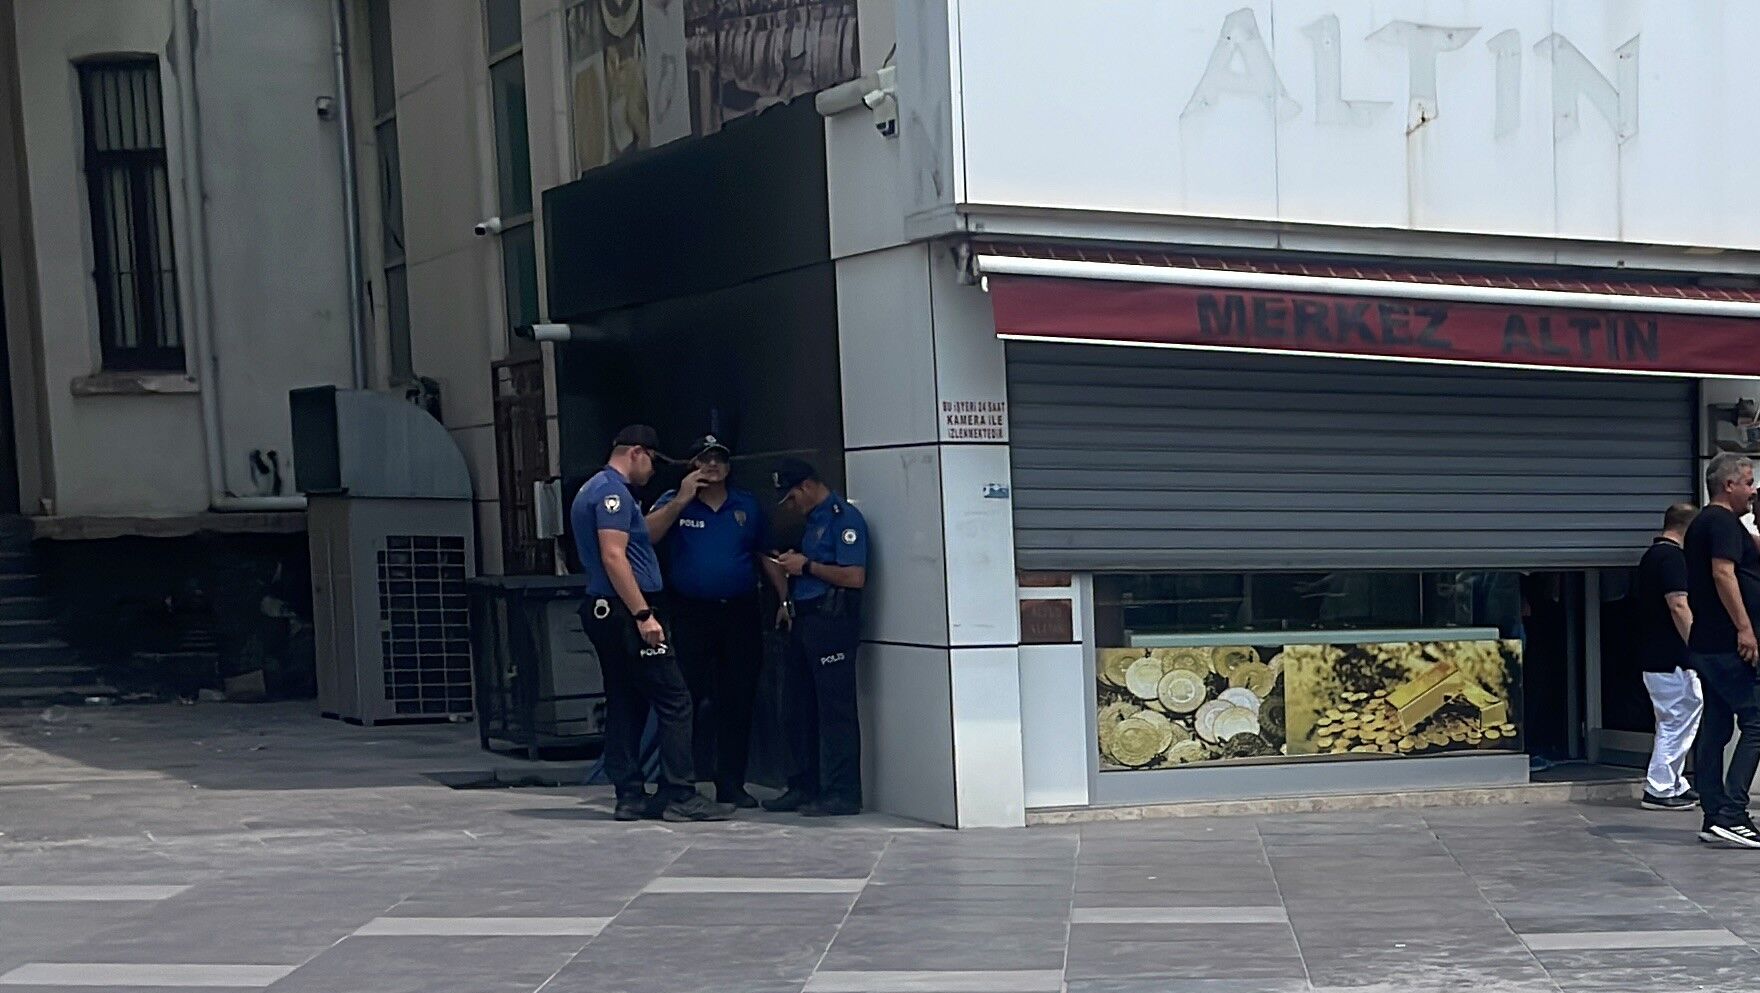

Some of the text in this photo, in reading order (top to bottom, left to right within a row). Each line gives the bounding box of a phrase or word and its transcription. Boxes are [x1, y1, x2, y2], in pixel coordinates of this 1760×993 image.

[1179, 7, 1641, 147] ALTIN
[1197, 294, 1660, 362] MERKEZ ALTIN
[946, 414, 986, 425] KAMERA
